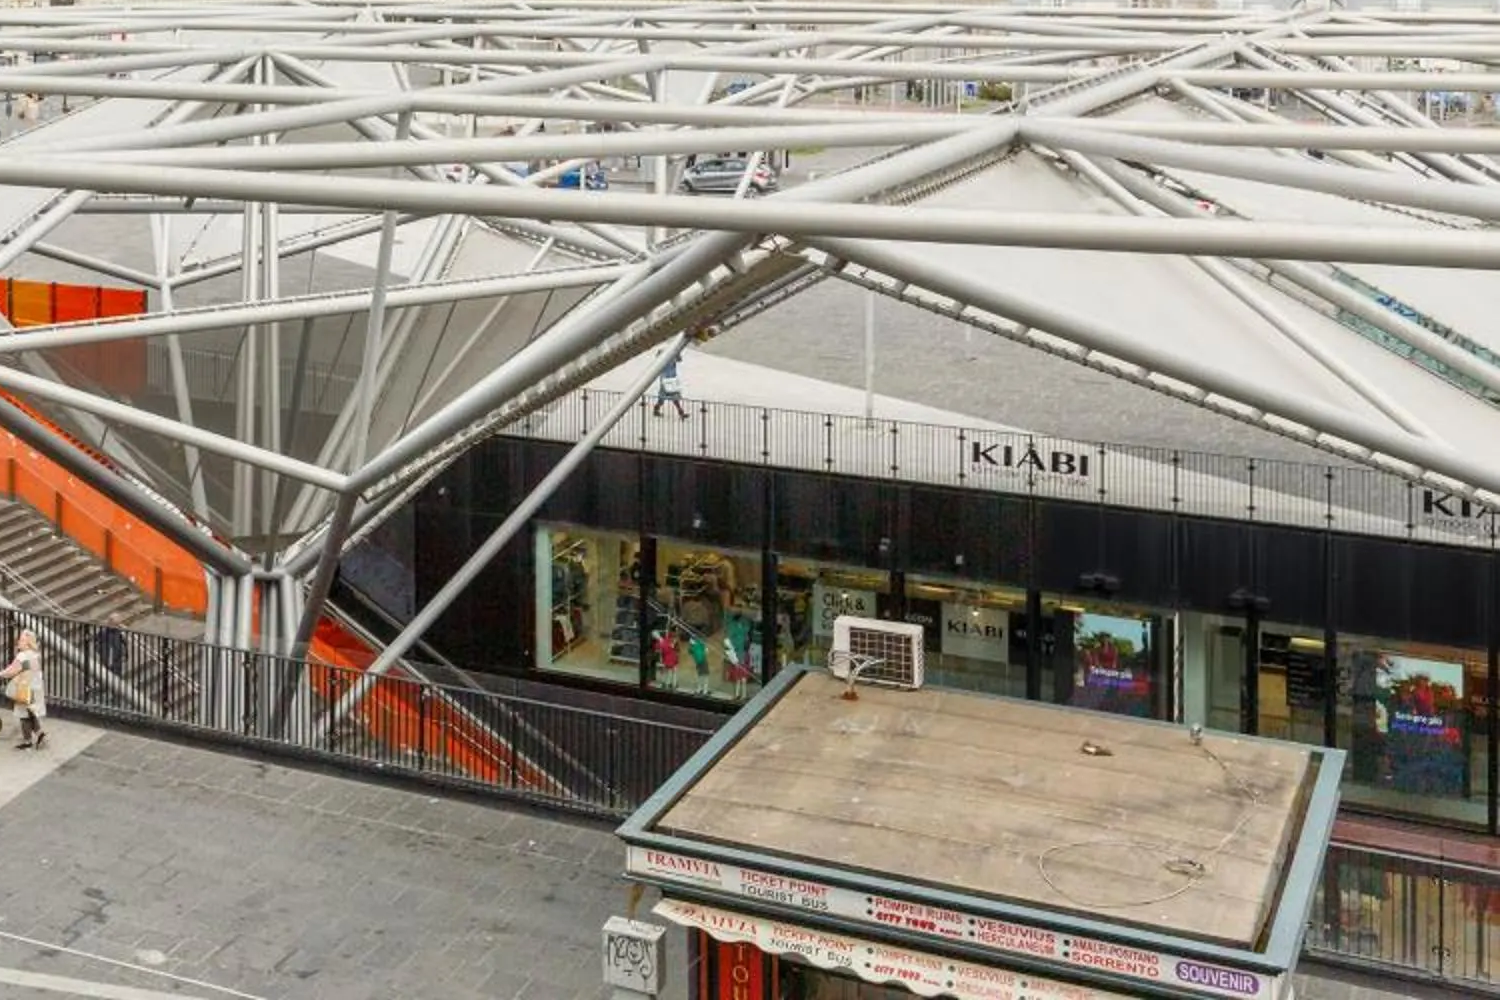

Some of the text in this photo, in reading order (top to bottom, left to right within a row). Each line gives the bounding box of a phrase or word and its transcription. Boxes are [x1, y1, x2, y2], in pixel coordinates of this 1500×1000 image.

[972, 441, 1089, 477] KIABI
[1423, 489, 1488, 519] KI
[947, 620, 1003, 639] KIABI
[647, 851, 722, 878] TRAMVIA
[740, 869, 830, 897] TICKET POINT
[740, 883, 829, 911] TOURIST BUS
[875, 911, 902, 923] CITY
[772, 925, 856, 953] TICKET POINT
[977, 920, 1056, 944] VESUVIUS
[827, 950, 854, 968] BUS
[1071, 951, 1160, 977] SORRENTO
[1179, 963, 1254, 992] SOUVENIR
